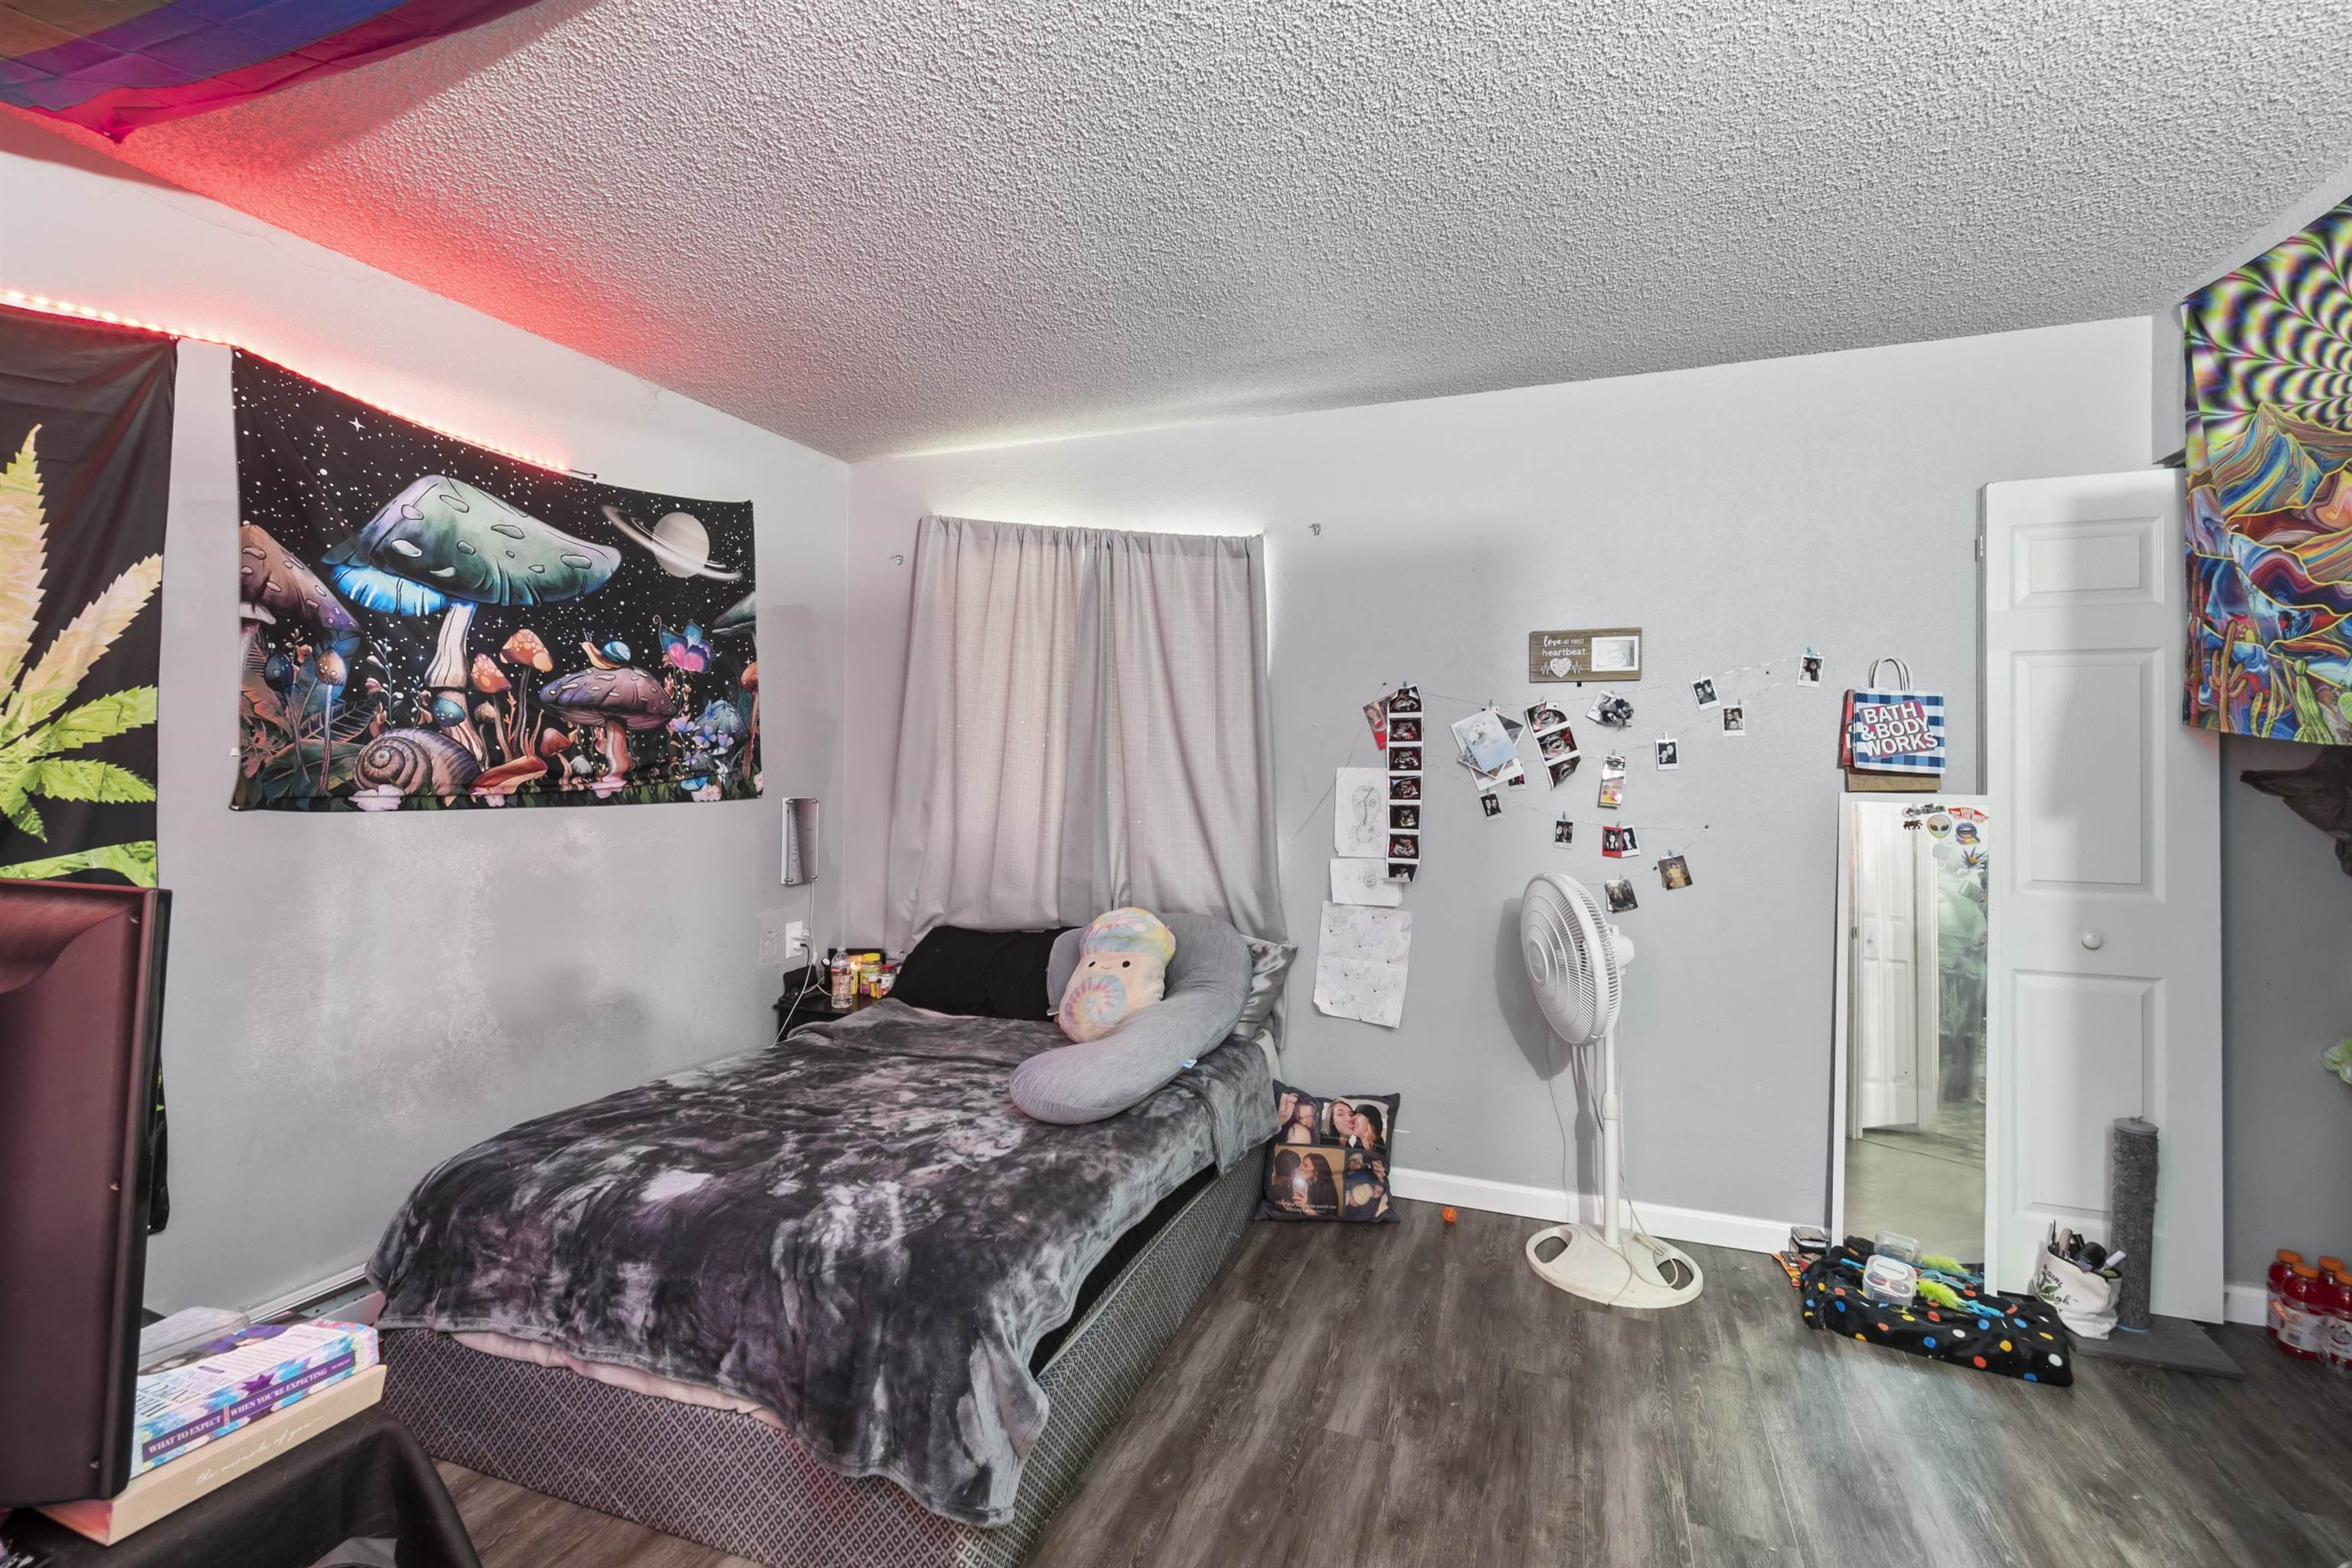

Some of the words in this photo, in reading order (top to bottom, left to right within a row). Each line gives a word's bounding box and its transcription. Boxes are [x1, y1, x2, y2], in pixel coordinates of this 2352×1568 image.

[1542, 648, 1586, 656] heartbeat
[1544, 635, 1563, 647] love
[1863, 702, 1918, 724] BATH
[1860, 725, 1877, 741] &
[1875, 716, 1929, 739] BODY
[1864, 731, 1939, 756] WORKS
[2047, 1271, 2063, 1288] GIRL
[149, 1436, 175, 1453] WHAT
[177, 1430, 189, 1441] TO
[189, 1416, 221, 1436] EXPECT
[230, 1398, 256, 1416] WHEN
[256, 1385, 286, 1404] YOU'RE
[286, 1368, 328, 1392] EXPECTING
